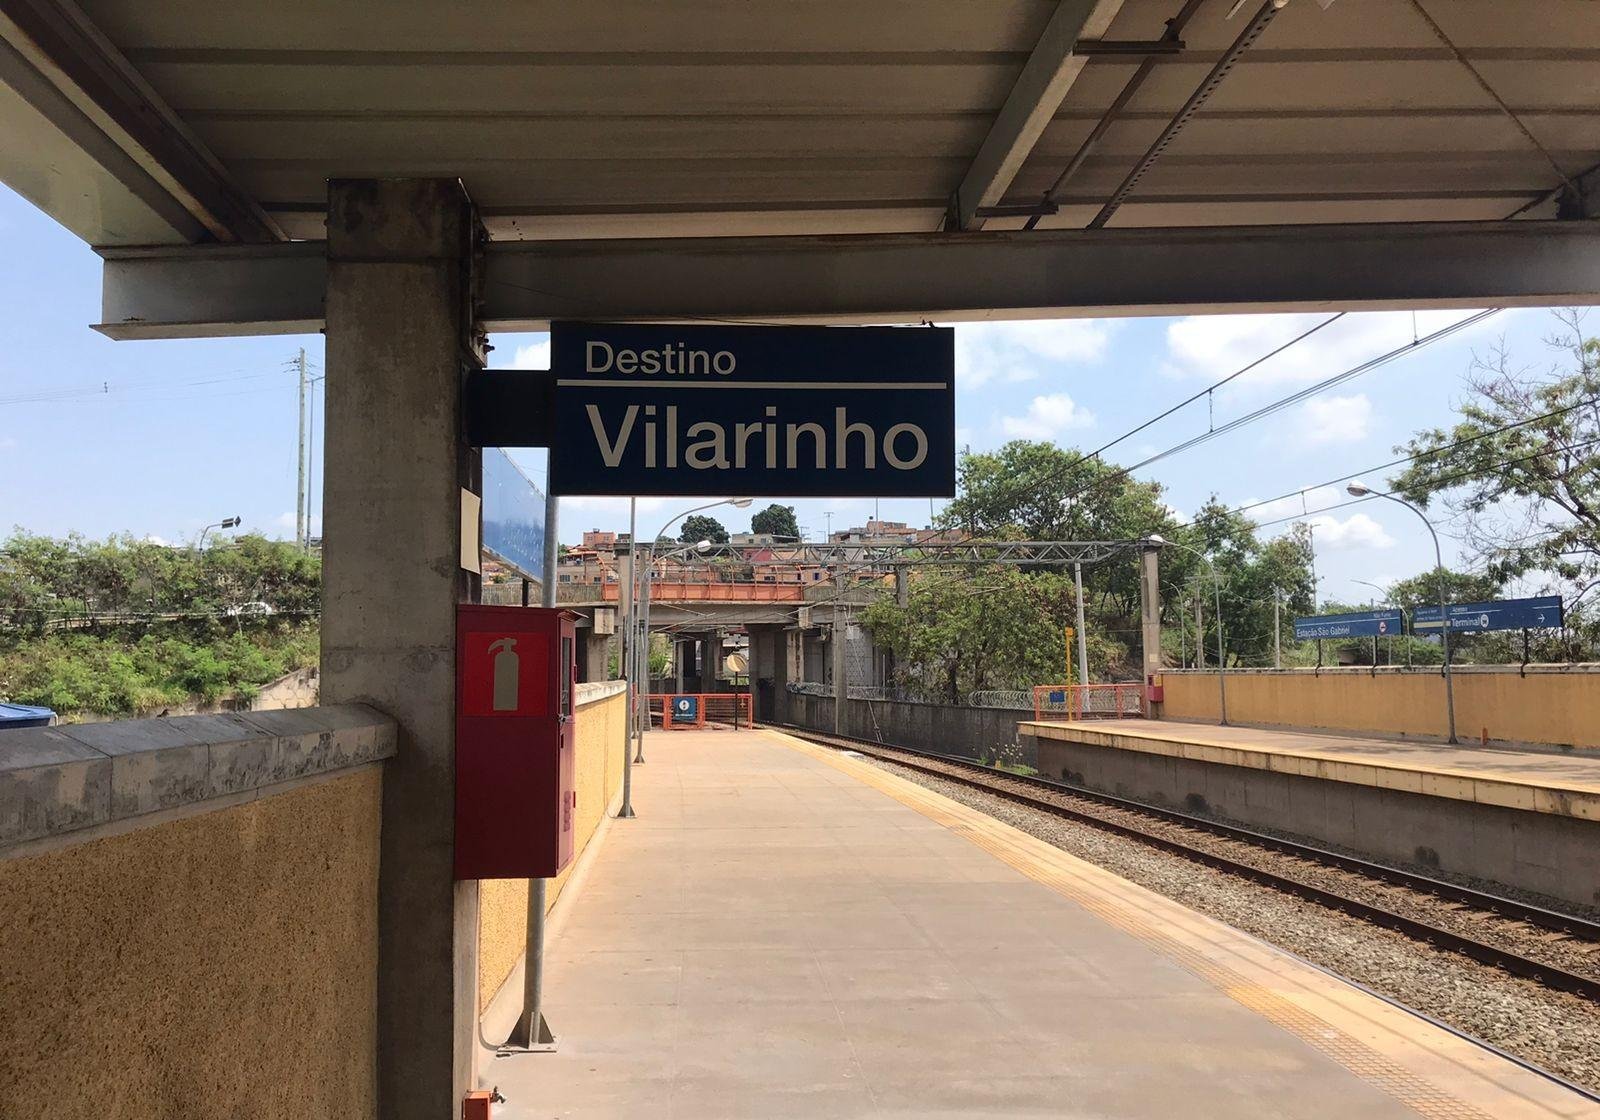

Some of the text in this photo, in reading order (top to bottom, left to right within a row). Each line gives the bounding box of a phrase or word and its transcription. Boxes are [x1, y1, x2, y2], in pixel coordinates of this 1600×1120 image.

[585, 341, 737, 375] Destino
[585, 404, 929, 471] Vilarinho
[1296, 627, 1317, 639] Estação
[1330, 624, 1350, 636] Gabriel
[1451, 617, 1480, 627] Terminal
